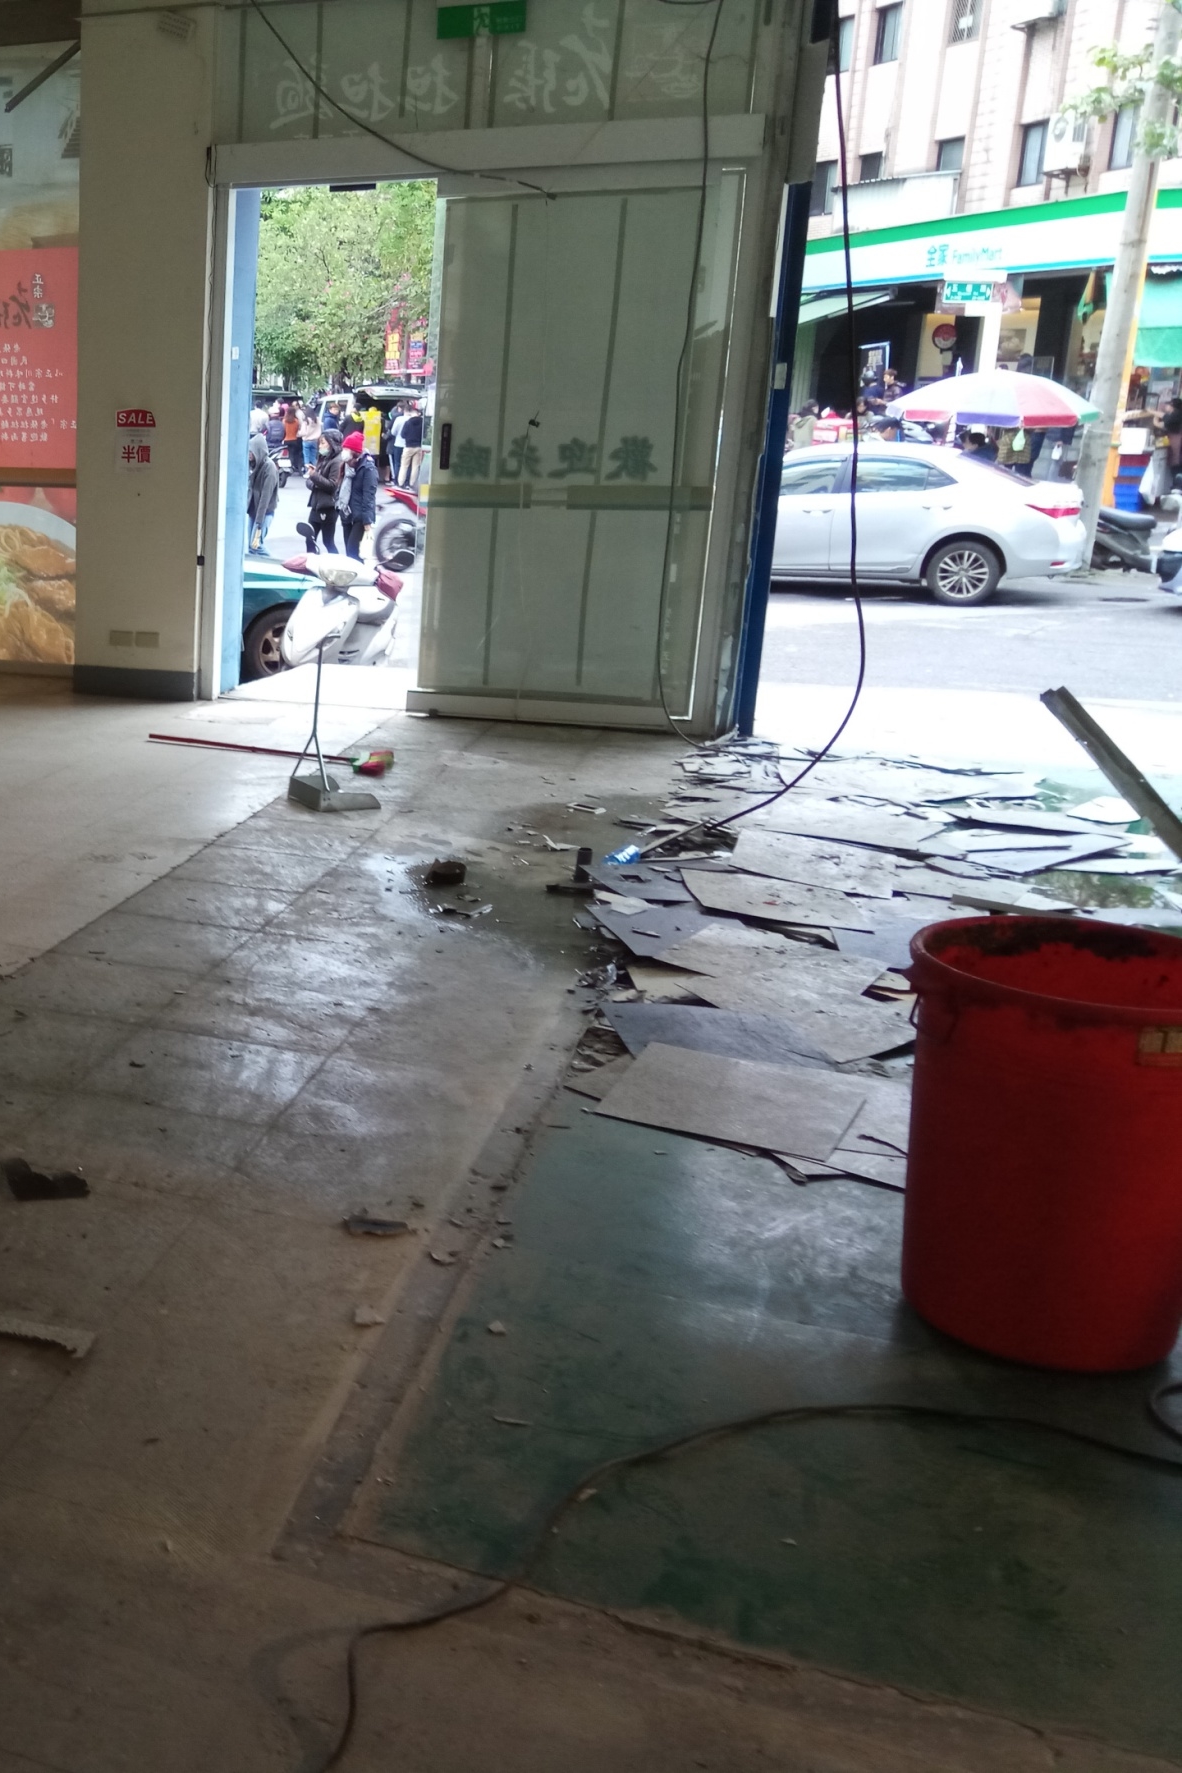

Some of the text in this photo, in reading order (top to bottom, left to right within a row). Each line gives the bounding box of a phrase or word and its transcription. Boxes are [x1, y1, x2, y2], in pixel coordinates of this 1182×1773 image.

[926, 244, 1002, 268] 全家 FamilyMart
[118, 412, 153, 424] SALE
[121, 444, 151, 464] 半價
